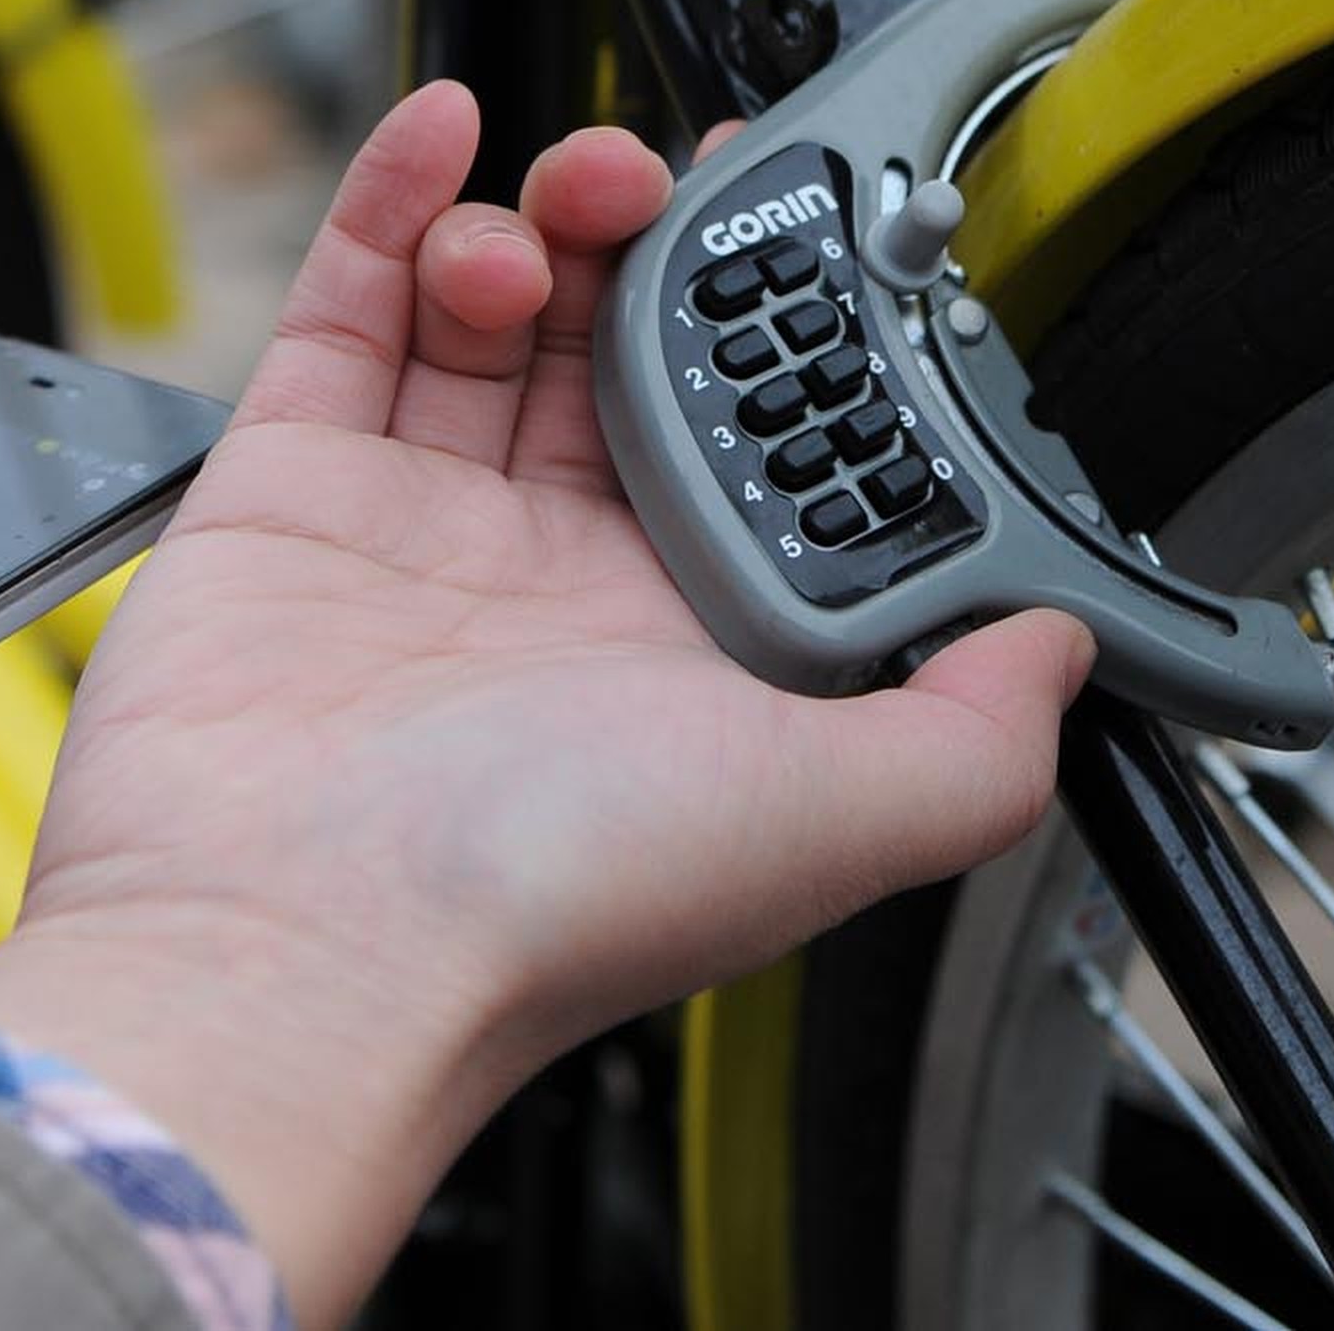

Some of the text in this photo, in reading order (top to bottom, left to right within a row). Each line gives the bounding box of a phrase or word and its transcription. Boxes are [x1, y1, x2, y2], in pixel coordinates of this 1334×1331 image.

[701, 183, 839, 257] GORIN
[820, 237, 844, 260] 6
[837, 292, 857, 315] 7
[673, 309, 697, 330] 1
[684, 368, 710, 391] 2
[712, 426, 737, 449] 3
[931, 457, 954, 480] 0
[743, 480, 765, 504] 4
[778, 533, 804, 559] 5
